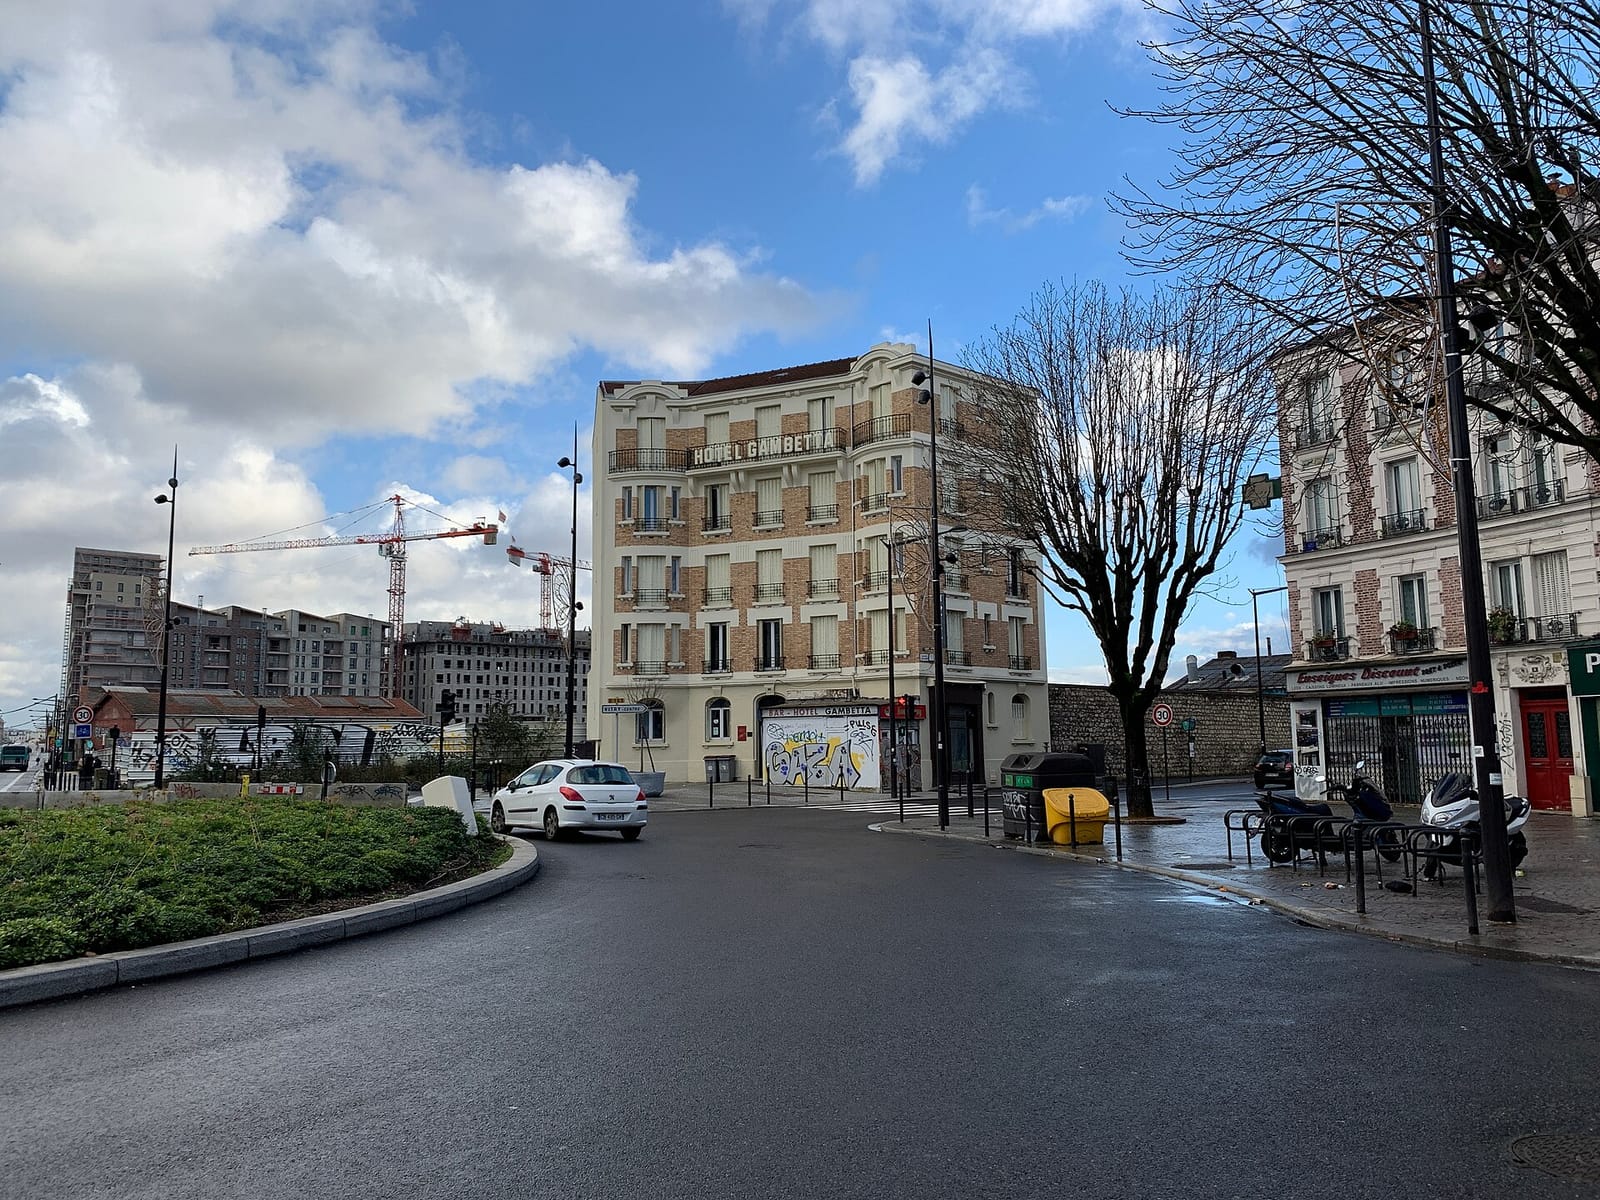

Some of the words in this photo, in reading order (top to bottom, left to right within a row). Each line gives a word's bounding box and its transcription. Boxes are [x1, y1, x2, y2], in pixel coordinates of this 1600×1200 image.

[694, 442, 742, 465] HOTEL
[747, 431, 834, 457] GAMBETTA
[1586, 653, 1600, 673] P
[1296, 671, 1358, 685] Enseignes
[1361, 667, 1420, 680] Discount
[76, 711, 89, 719] 30
[768, 709, 784, 717] BAR
[793, 708, 818, 716] HOTEL
[825, 706, 871, 715] GAMBETTA
[1157, 710, 1168, 720] 30
[765, 739, 861, 790] GAZA
